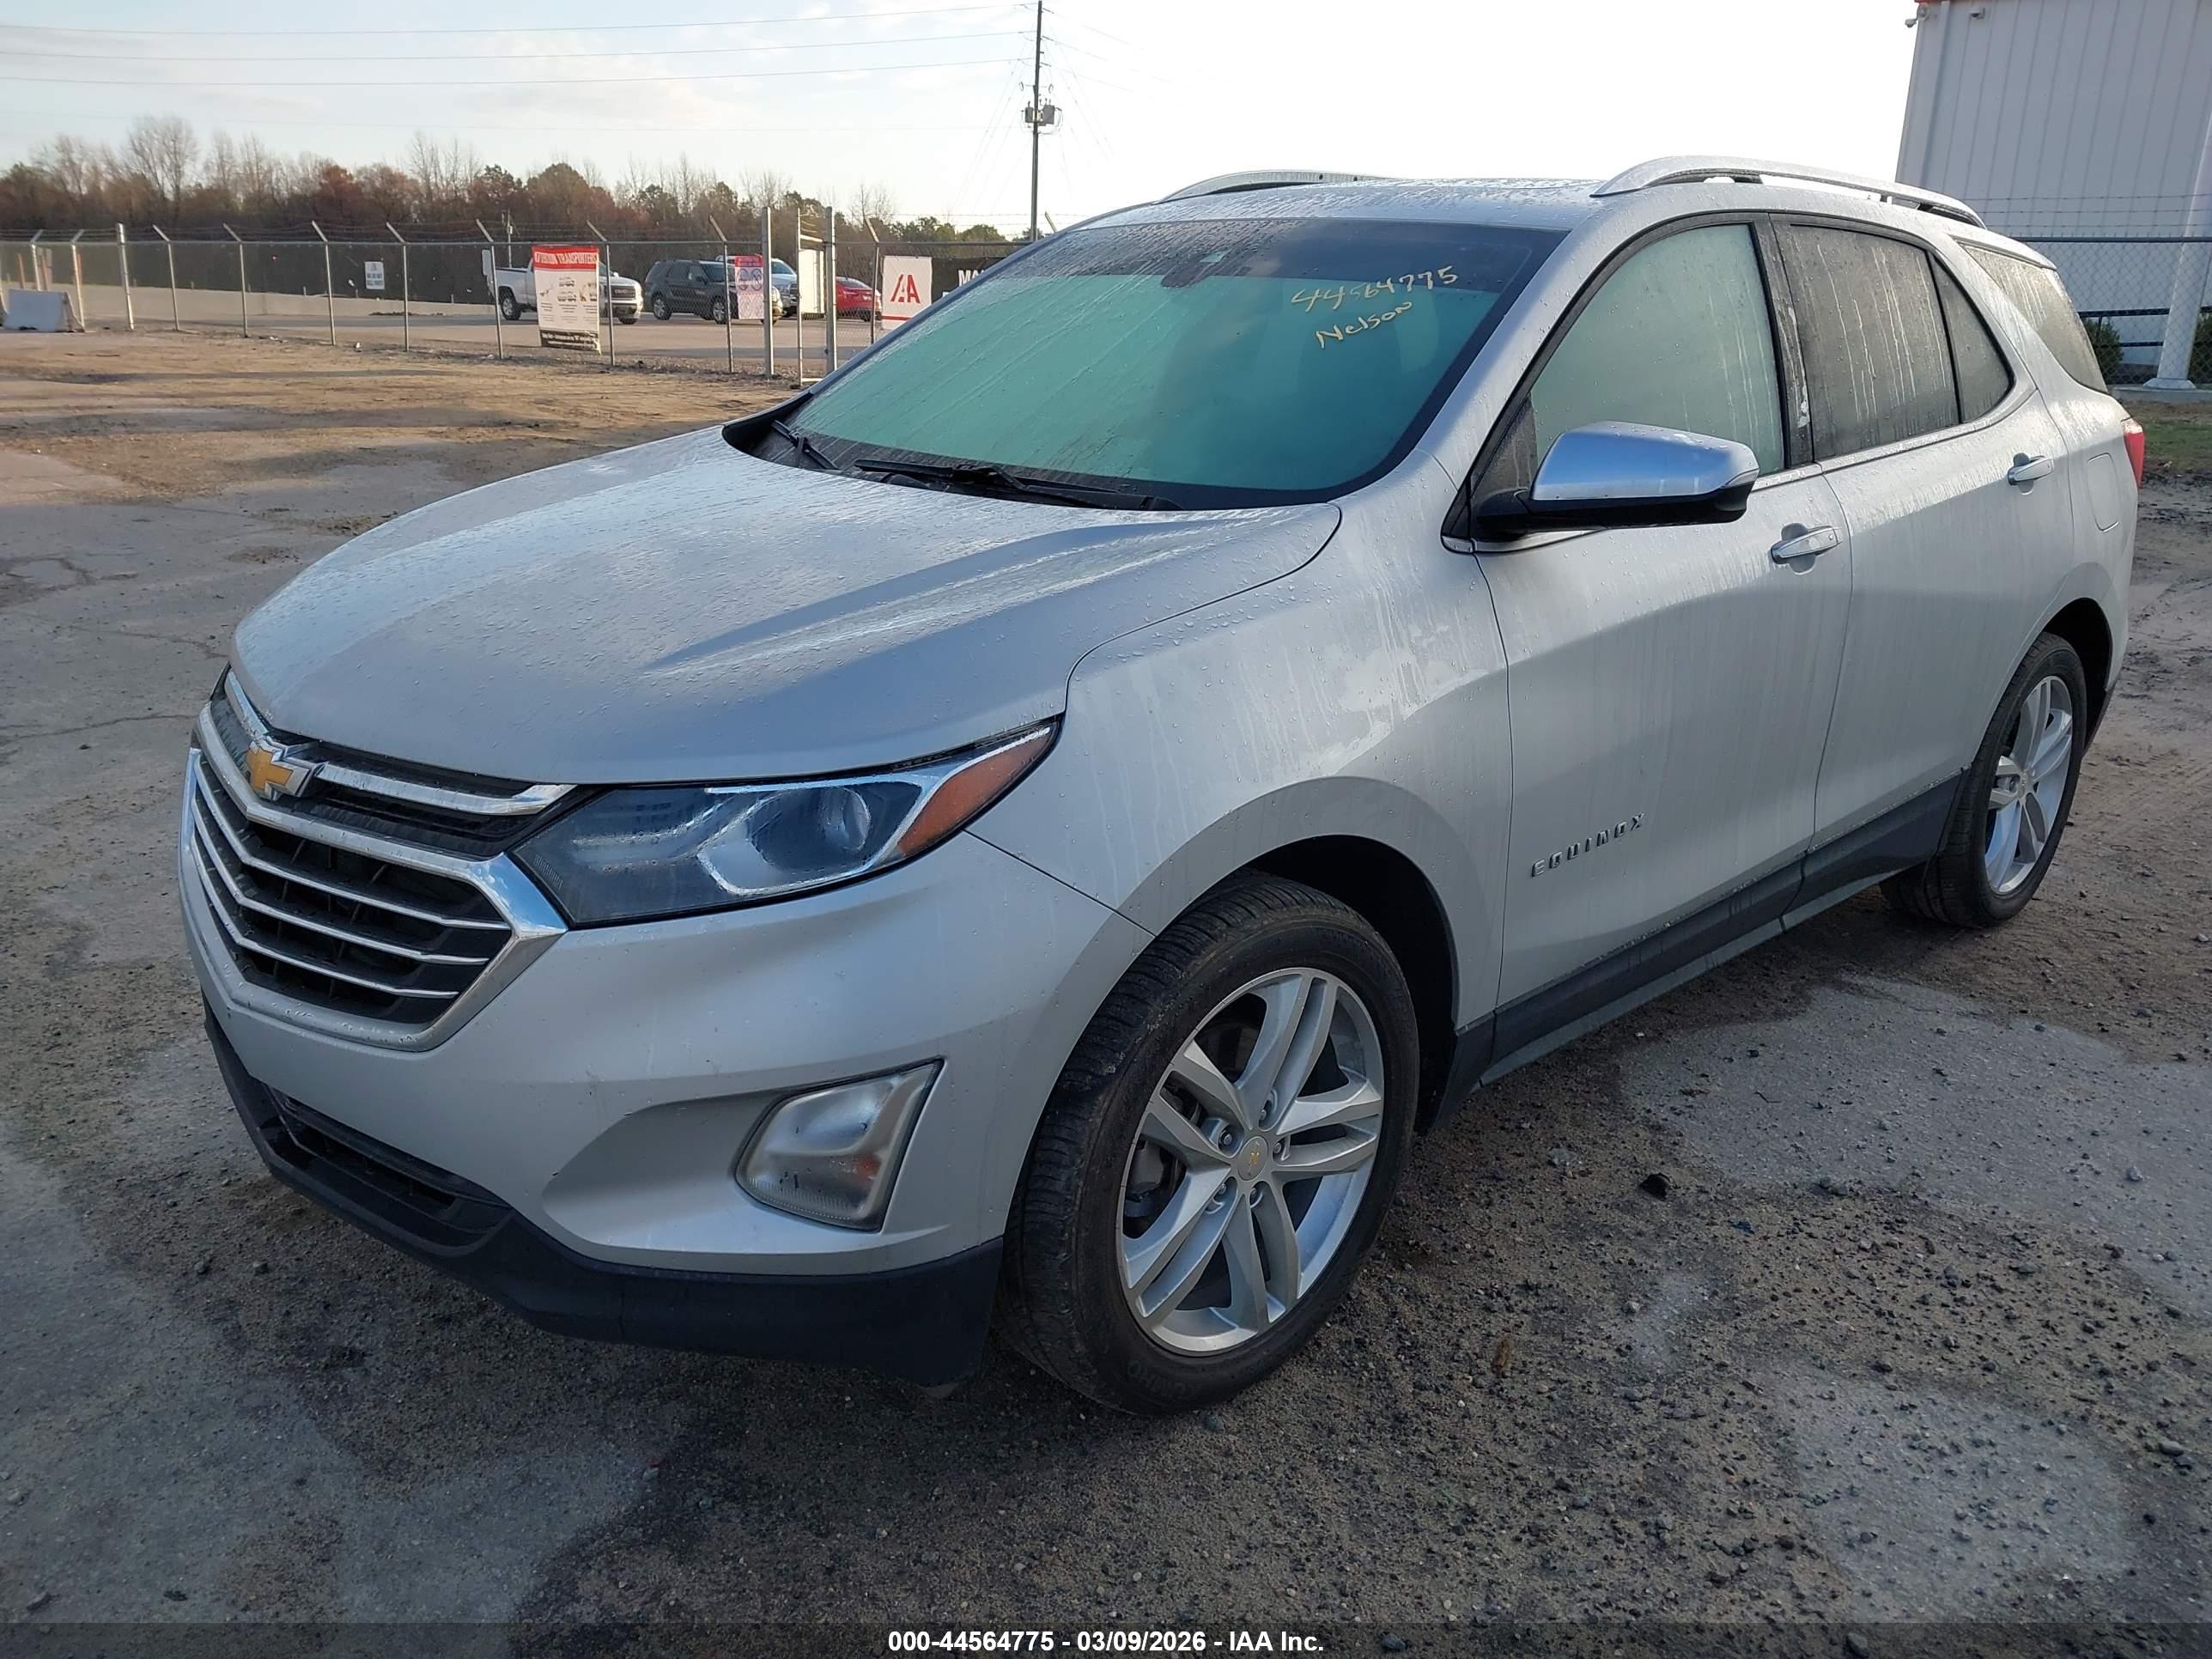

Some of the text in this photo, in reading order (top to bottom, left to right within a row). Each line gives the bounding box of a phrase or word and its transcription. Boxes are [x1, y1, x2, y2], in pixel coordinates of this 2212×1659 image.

[1291, 265, 1459, 312] 44564775
[1316, 301, 1413, 349] Nelson
[1530, 811, 1646, 878] EQUINOX
